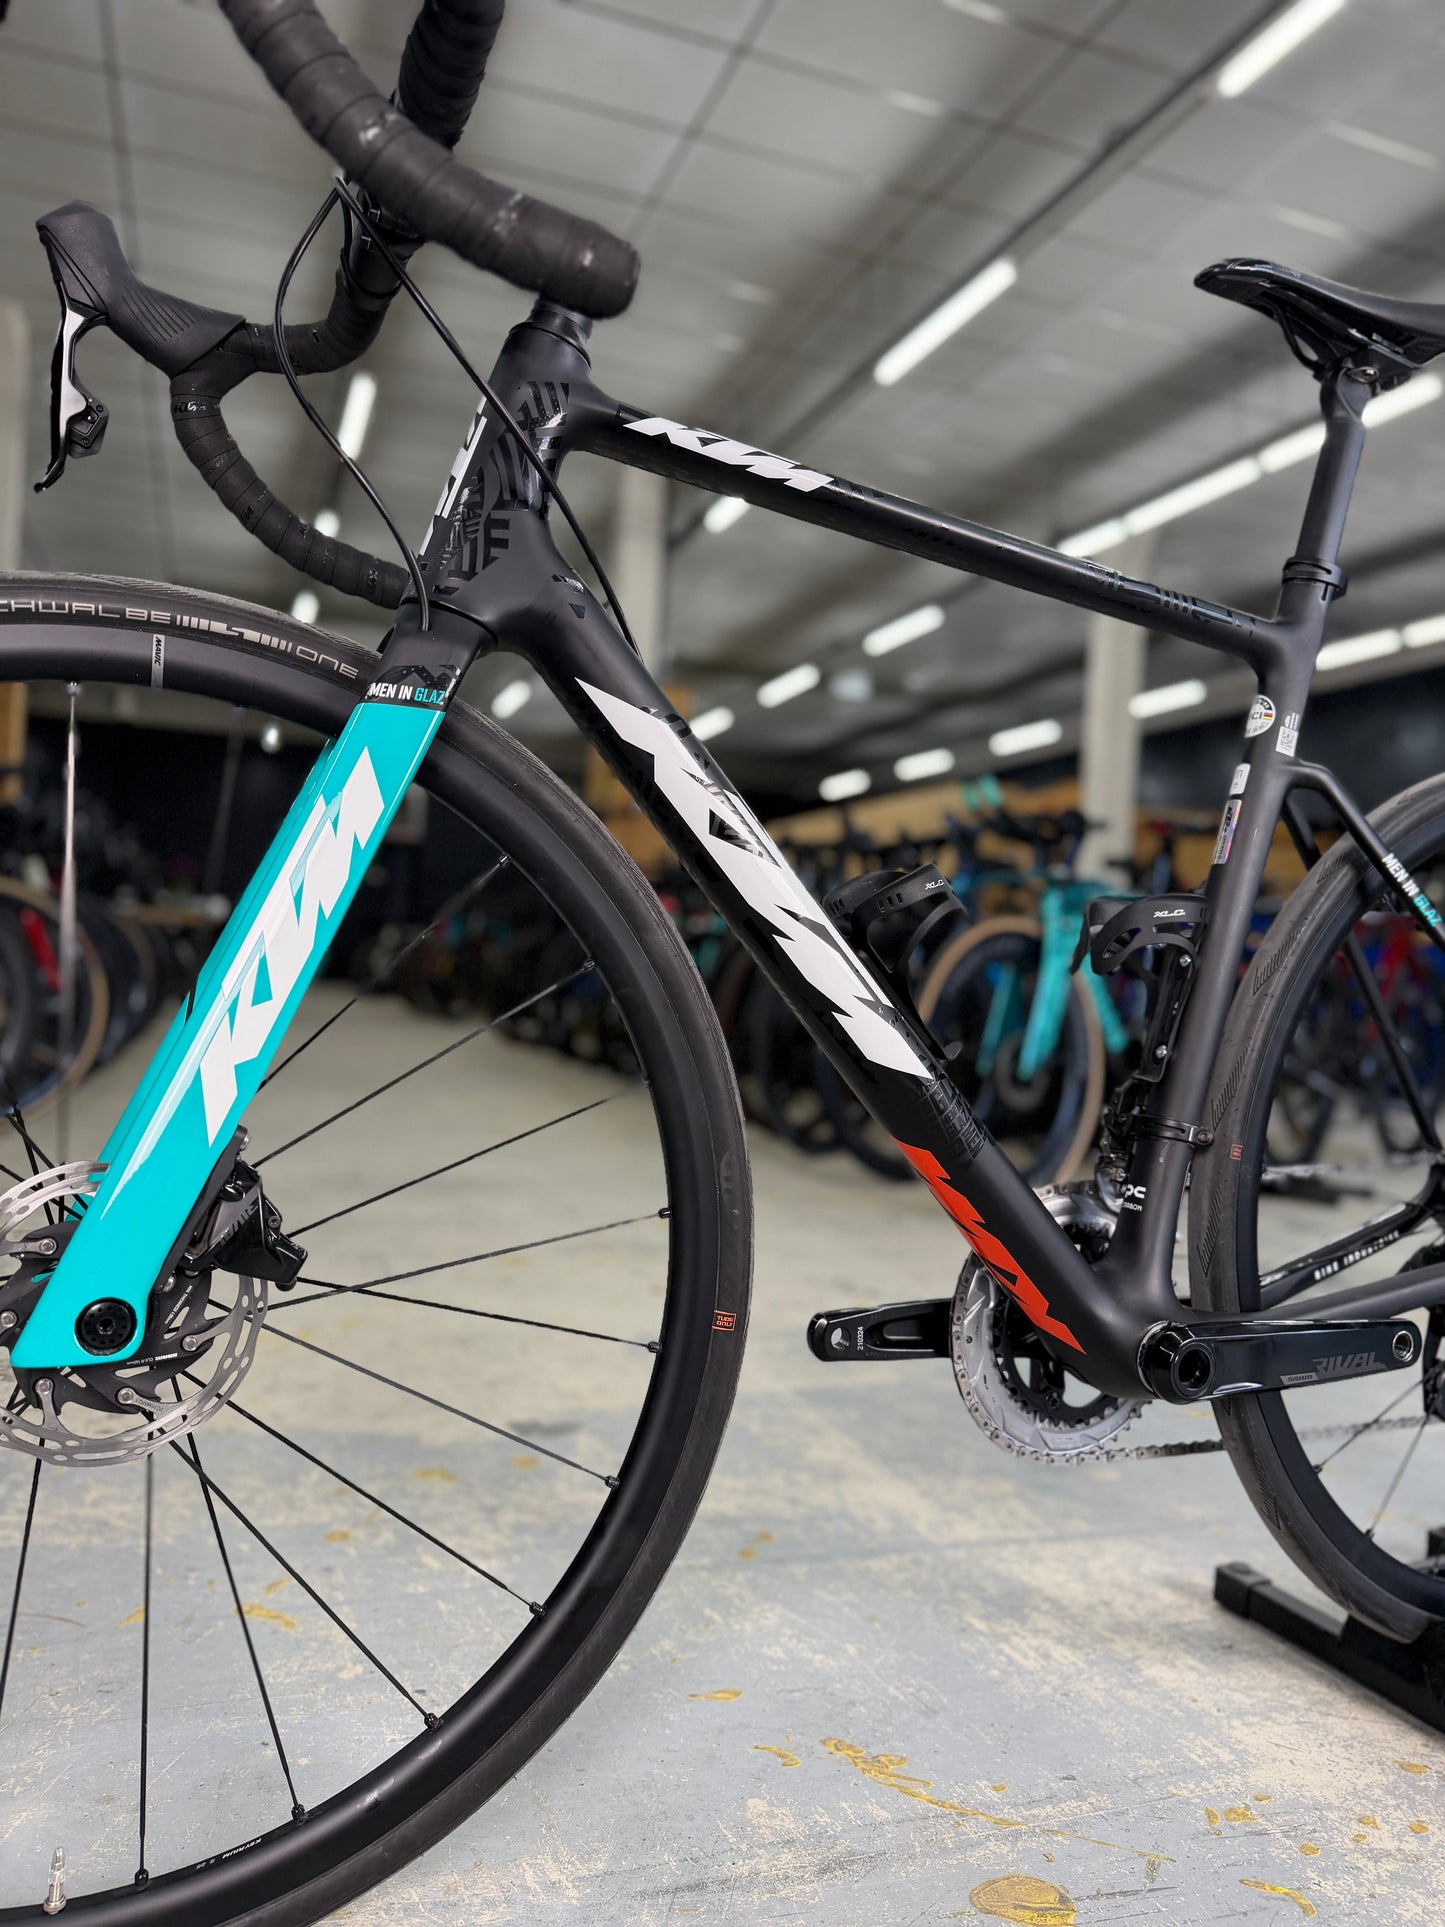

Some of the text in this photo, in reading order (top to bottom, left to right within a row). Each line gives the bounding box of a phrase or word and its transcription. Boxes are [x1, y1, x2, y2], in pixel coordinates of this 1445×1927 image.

[622, 417, 835, 493] KTM
[0, 599, 171, 624] HWALBE
[154, 636, 163, 667] MAVIC
[296, 645, 359, 679] ONE
[366, 682, 446, 705] MEN IN GLAZ
[575, 677, 934, 1080] KTM
[924, 879, 945, 890] XLC
[1381, 852, 1443, 928] MEN IN GLAZ
[199, 746, 385, 1148] KTM
[1287, 1374, 1313, 1382] SRAM
[1312, 1352, 1387, 1375] RIVAL
